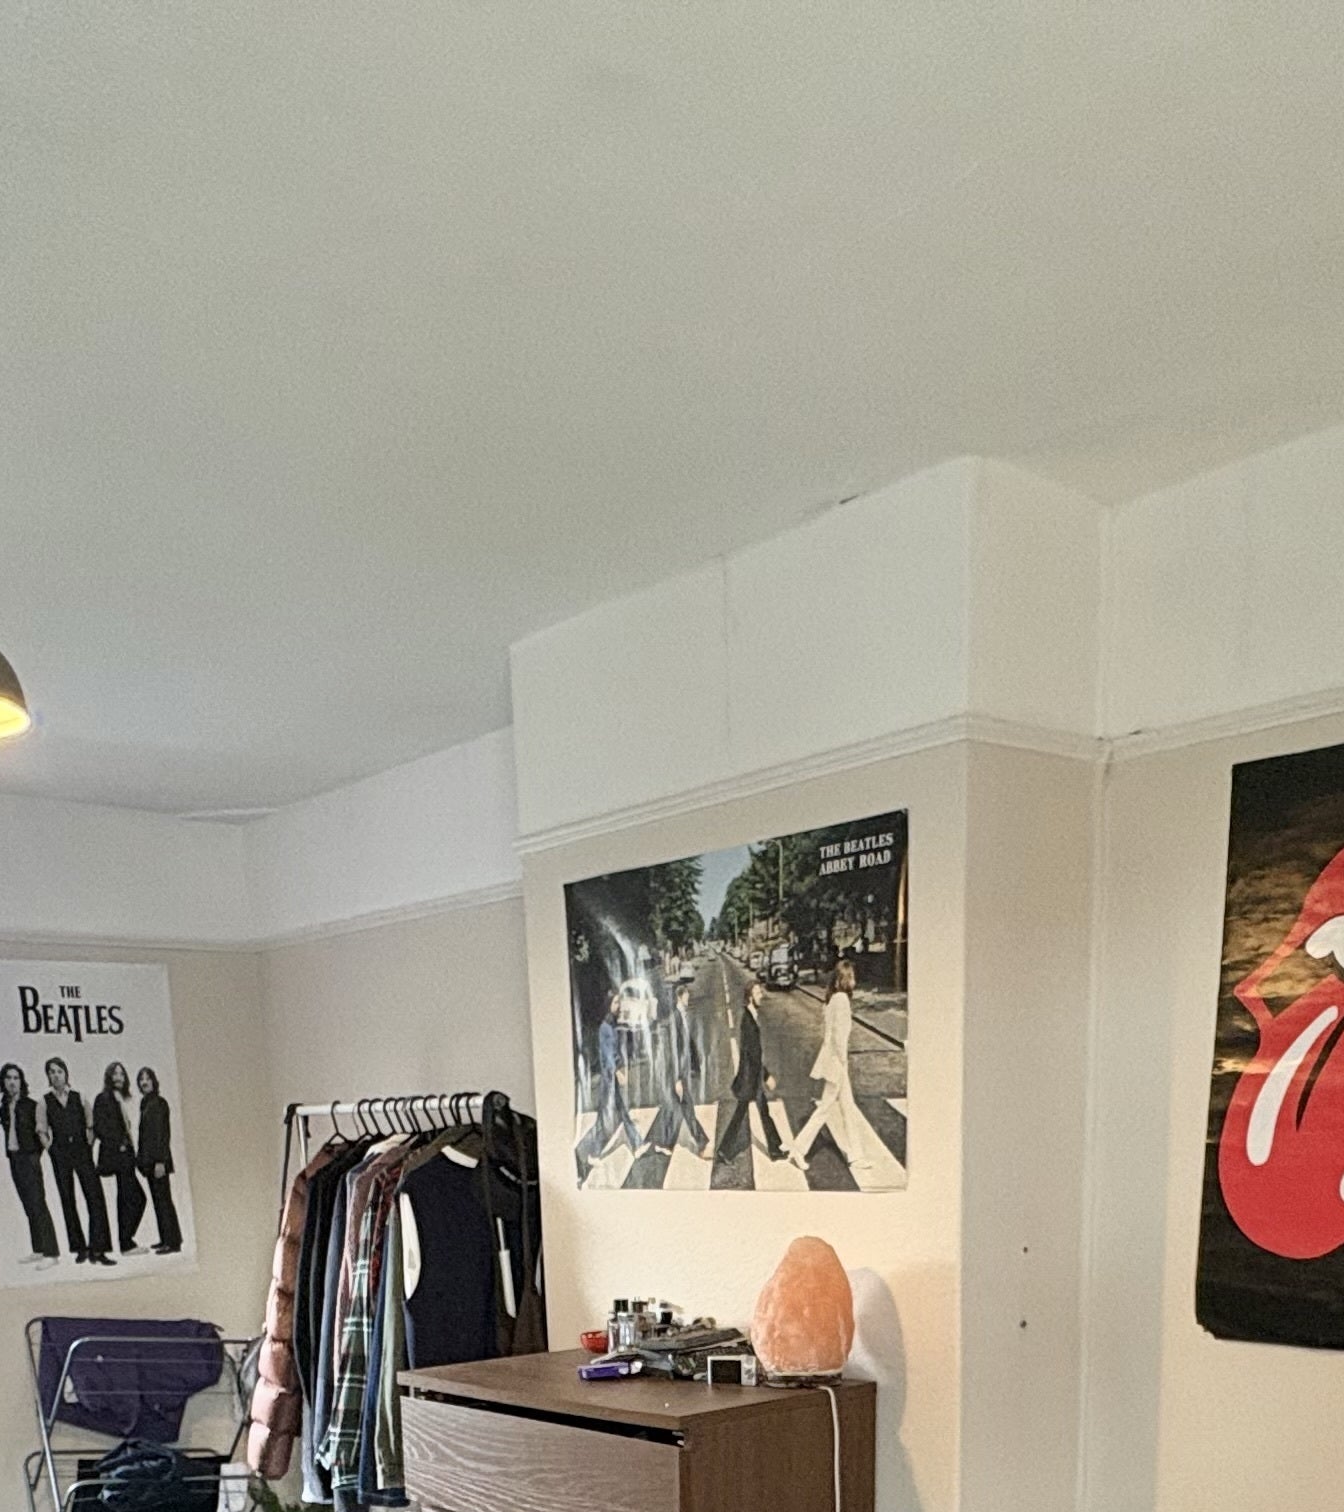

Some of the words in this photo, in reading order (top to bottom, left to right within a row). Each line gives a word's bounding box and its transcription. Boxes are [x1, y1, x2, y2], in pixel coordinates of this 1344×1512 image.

[819, 843, 842, 858] THE
[843, 833, 894, 854] BEATLES
[819, 856, 855, 876] ABBEY
[859, 850, 891, 868] ROAD
[59, 985, 81, 999] THE
[17, 985, 124, 1042] BEATLES
